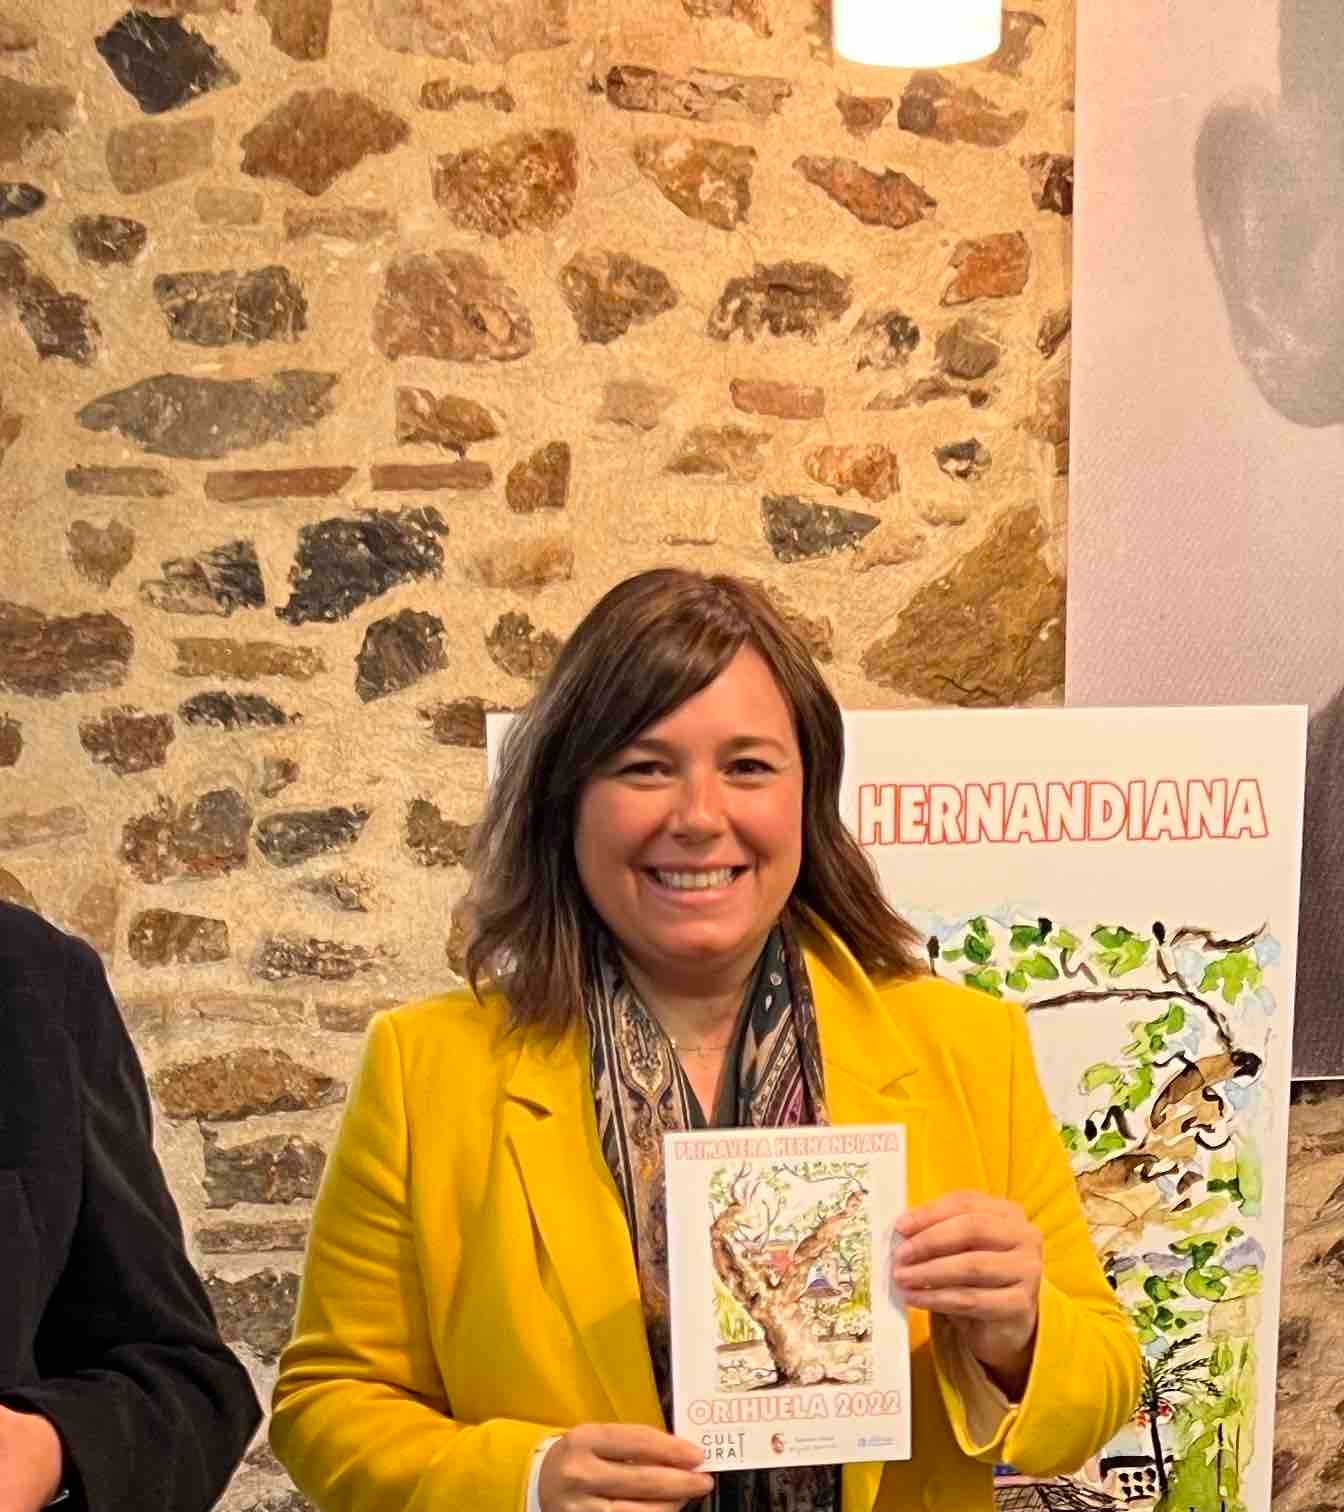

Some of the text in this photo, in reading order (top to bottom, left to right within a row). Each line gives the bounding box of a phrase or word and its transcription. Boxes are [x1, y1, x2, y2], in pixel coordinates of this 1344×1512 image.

[858, 778, 1269, 845] HERNANDIANA
[688, 1390, 901, 1425] ORIHUELA 2022
